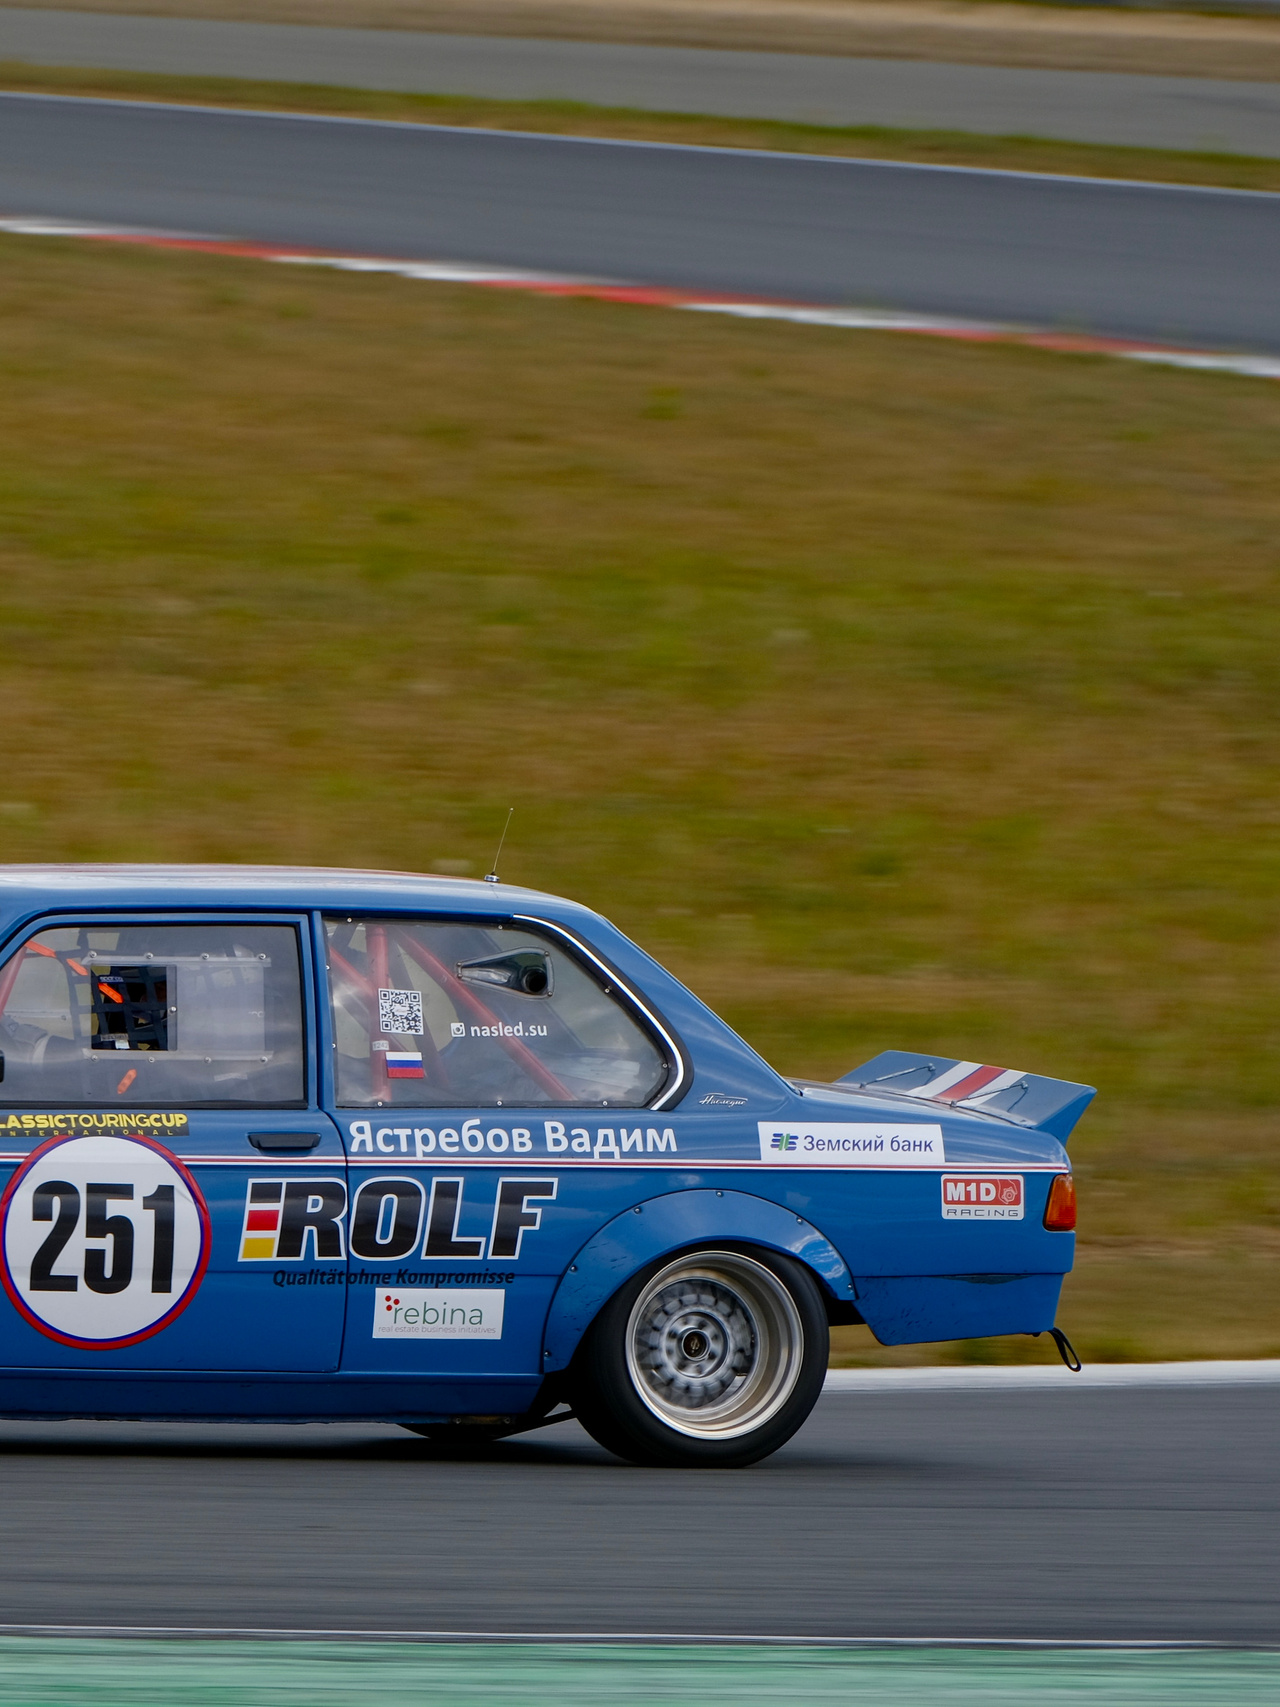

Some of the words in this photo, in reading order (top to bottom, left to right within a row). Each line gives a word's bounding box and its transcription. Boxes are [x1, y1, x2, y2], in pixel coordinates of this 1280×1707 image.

[471, 1021, 548, 1037] nasled.su
[349, 1118, 533, 1160] Ястребов
[544, 1120, 678, 1160] Вадим
[803, 1135, 885, 1152] Земский
[890, 1135, 934, 1152] банк
[946, 1182, 997, 1202] M1D
[276, 1176, 559, 1262] ROLF
[946, 1208, 1019, 1217] RACING
[29, 1180, 175, 1295] 251
[272, 1269, 345, 1287] Qualität
[347, 1269, 391, 1285] ohne
[396, 1268, 516, 1289] Kompromisse
[394, 1302, 483, 1326] rebina
[458, 1326, 497, 1334] initiatives
